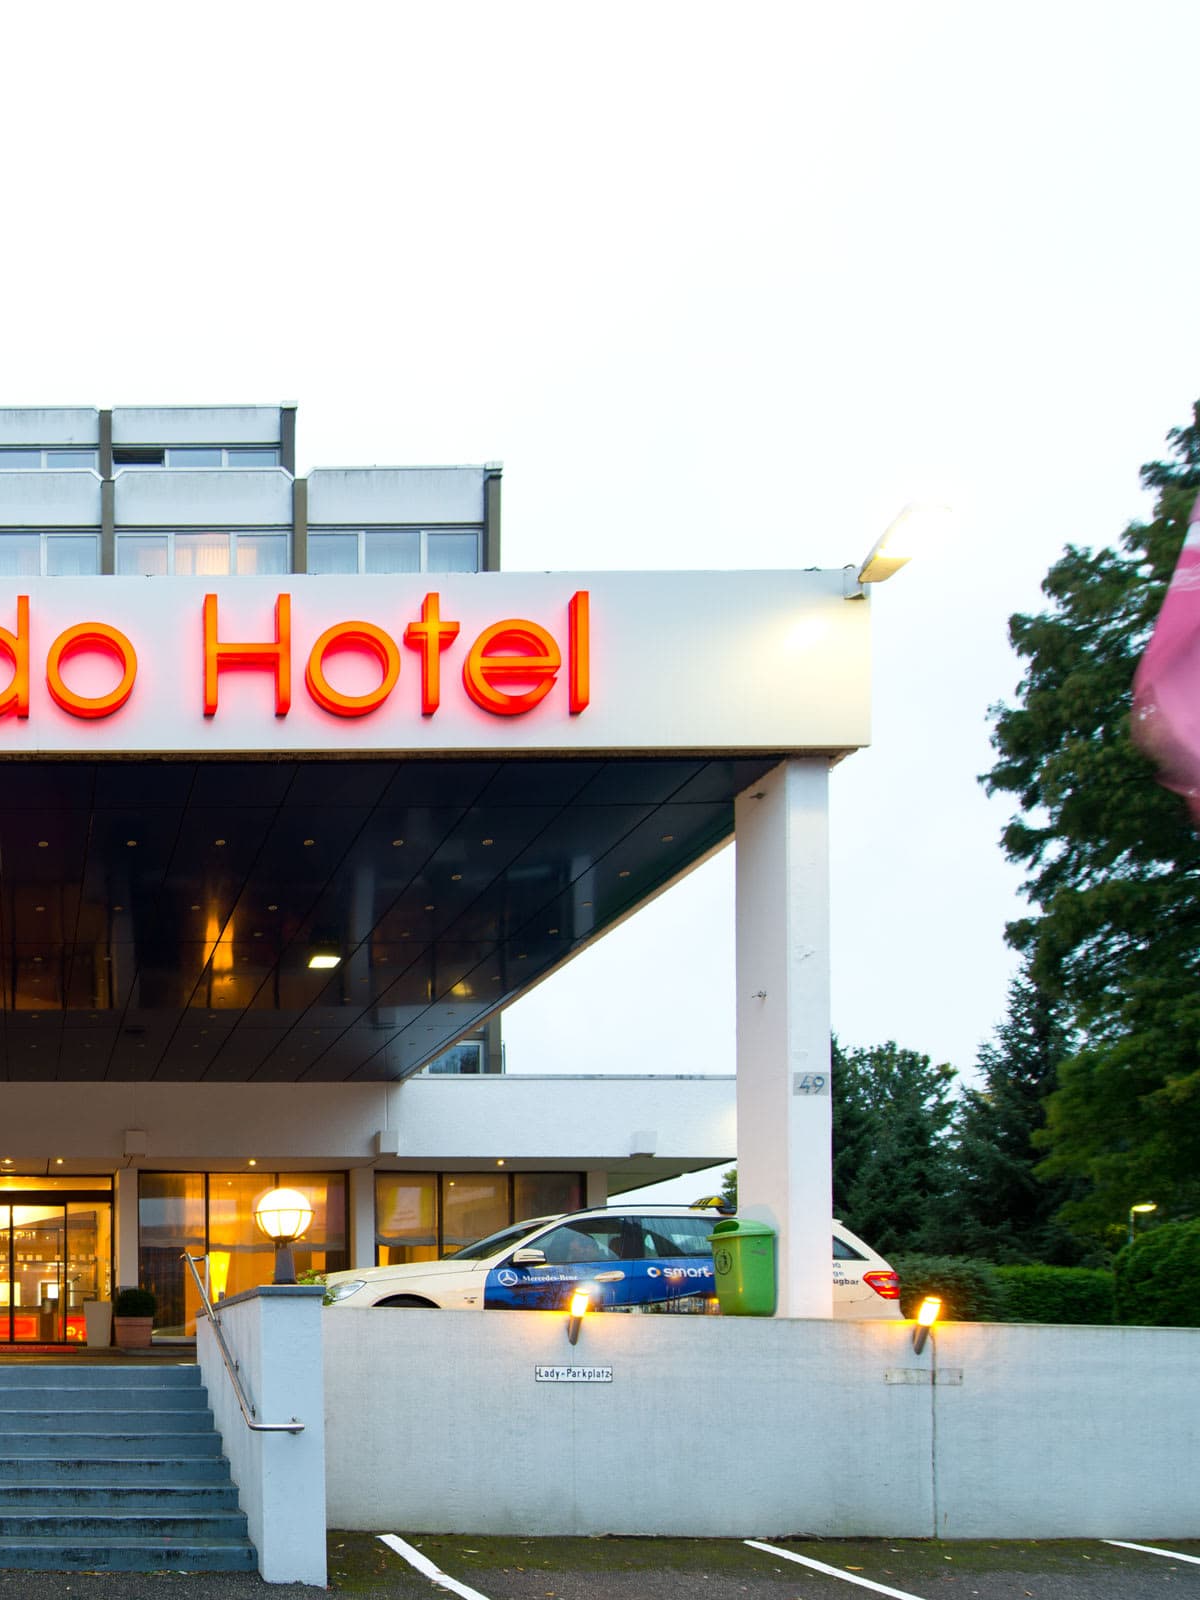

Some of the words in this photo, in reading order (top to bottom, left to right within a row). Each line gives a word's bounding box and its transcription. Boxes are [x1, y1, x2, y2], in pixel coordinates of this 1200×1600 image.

[202, 591, 590, 717] Hotel
[799, 1075, 825, 1094] 49
[522, 1273, 578, 1282] Mercedes-Benz
[663, 1266, 710, 1278] smart
[538, 1367, 610, 1380] Lady-Parkplatz
